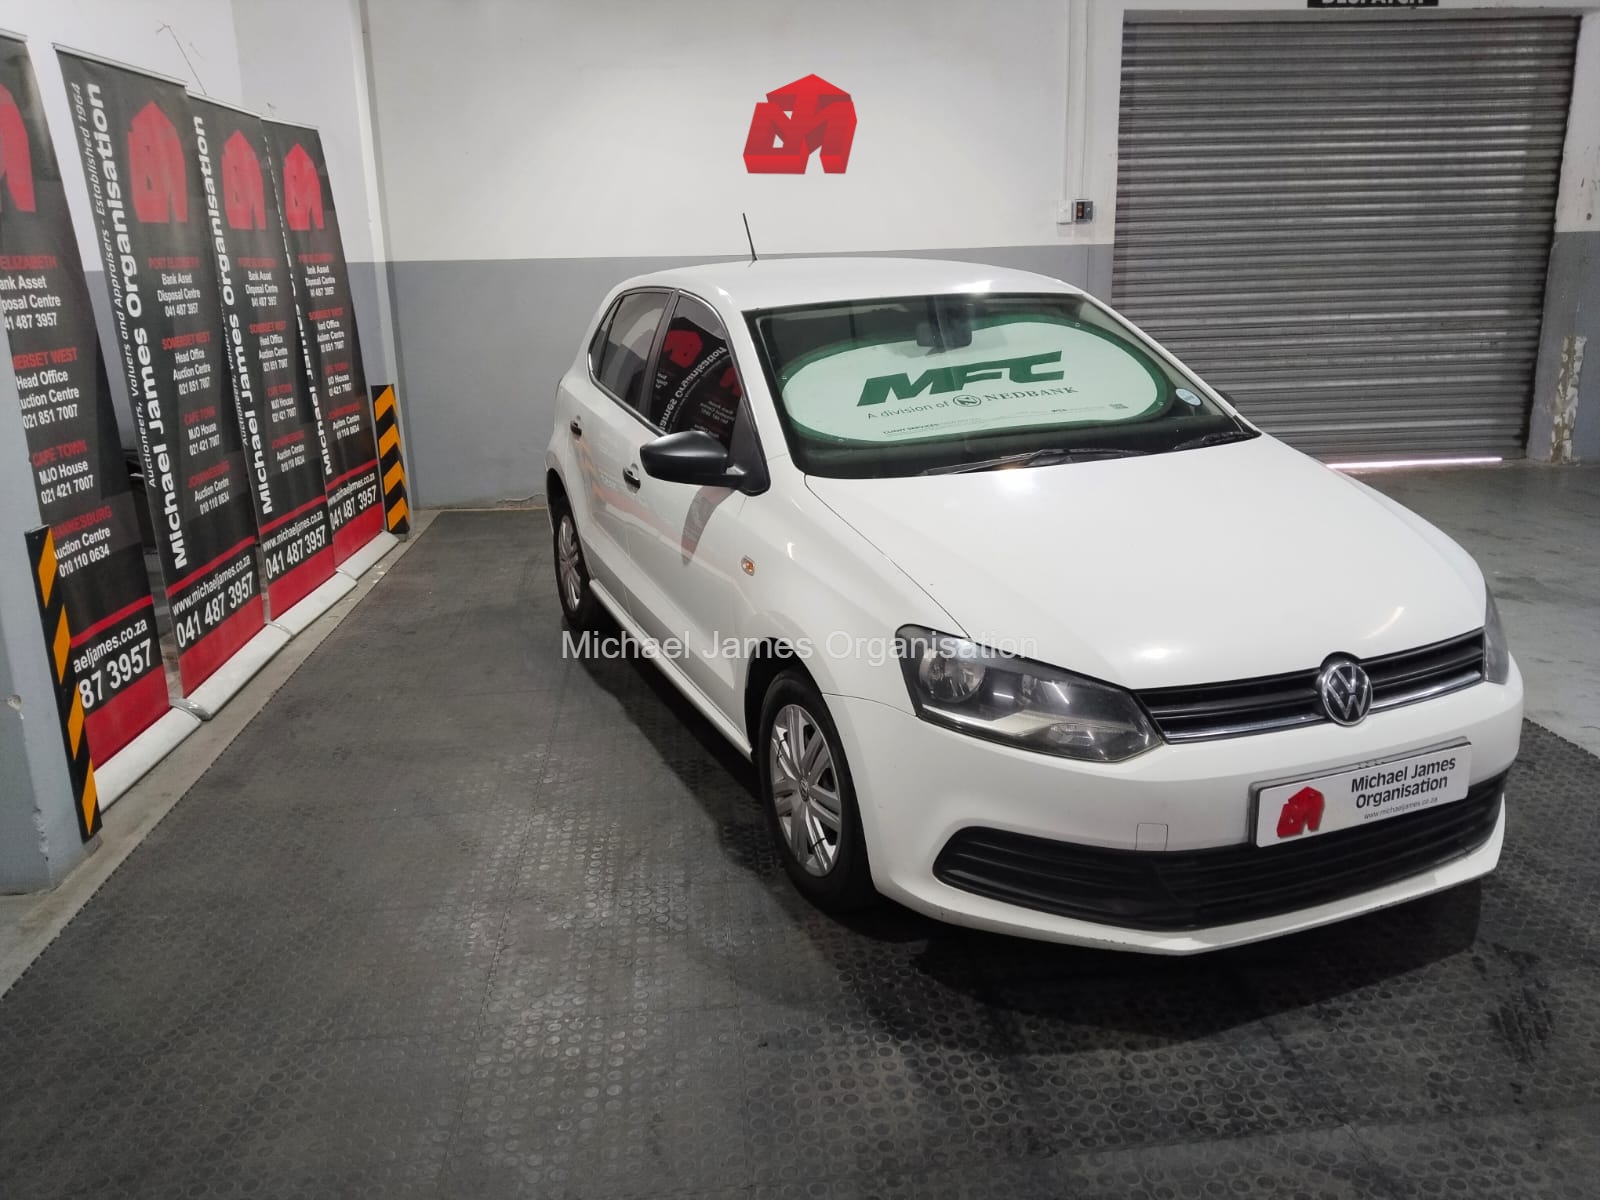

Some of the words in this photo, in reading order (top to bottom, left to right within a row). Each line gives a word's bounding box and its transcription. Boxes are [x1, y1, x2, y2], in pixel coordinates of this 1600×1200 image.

[71, 82, 88, 124] 1964
[83, 126, 106, 217] Established
[87, 82, 142, 318] Organisation
[193, 116, 235, 306] Organisation
[18, 275, 48, 290] Asset
[101, 229, 123, 309] Appraisers
[16, 314, 33, 329] 487
[36, 312, 58, 327] 3957
[30, 294, 62, 309] Centre
[116, 311, 128, 340] and
[123, 343, 139, 397] Valuers
[229, 314, 253, 403] James
[856, 350, 1065, 407] MFC
[16, 371, 39, 390] Head
[39, 370, 69, 385] Office
[48, 387, 80, 403] Centre
[134, 327, 164, 435] James
[22, 411, 38, 430] 021
[39, 407, 56, 425] 851
[56, 403, 79, 420] 7007
[867, 411, 879, 420] A
[881, 402, 933, 419] division
[935, 399, 951, 410] of
[984, 386, 1078, 402] NEDBANK
[39, 467, 57, 486] MJO
[59, 460, 89, 478] House
[245, 410, 273, 515] Michael
[40, 487, 56, 505] 021
[56, 481, 73, 498] 421
[73, 474, 95, 493] 7007
[153, 443, 187, 570] Michael
[343, 496, 356, 520] 487
[357, 484, 377, 511] 3957
[73, 552, 89, 570] 110
[89, 543, 111, 563] 0634
[81, 526, 112, 547] Centre
[265, 550, 285, 580] 041
[286, 538, 304, 566] 487
[304, 524, 326, 554] 3957
[172, 555, 251, 617] www.michaeljames.co.za
[176, 610, 202, 648] 041
[204, 592, 225, 626] 487
[228, 571, 253, 609] 3957
[73, 618, 148, 673] aeljames.co.za
[79, 669, 103, 709] 87
[106, 637, 152, 689] 3957
[1350, 765, 1408, 793] Michael
[1411, 756, 1456, 780] James
[1356, 775, 1448, 809] Organisation
